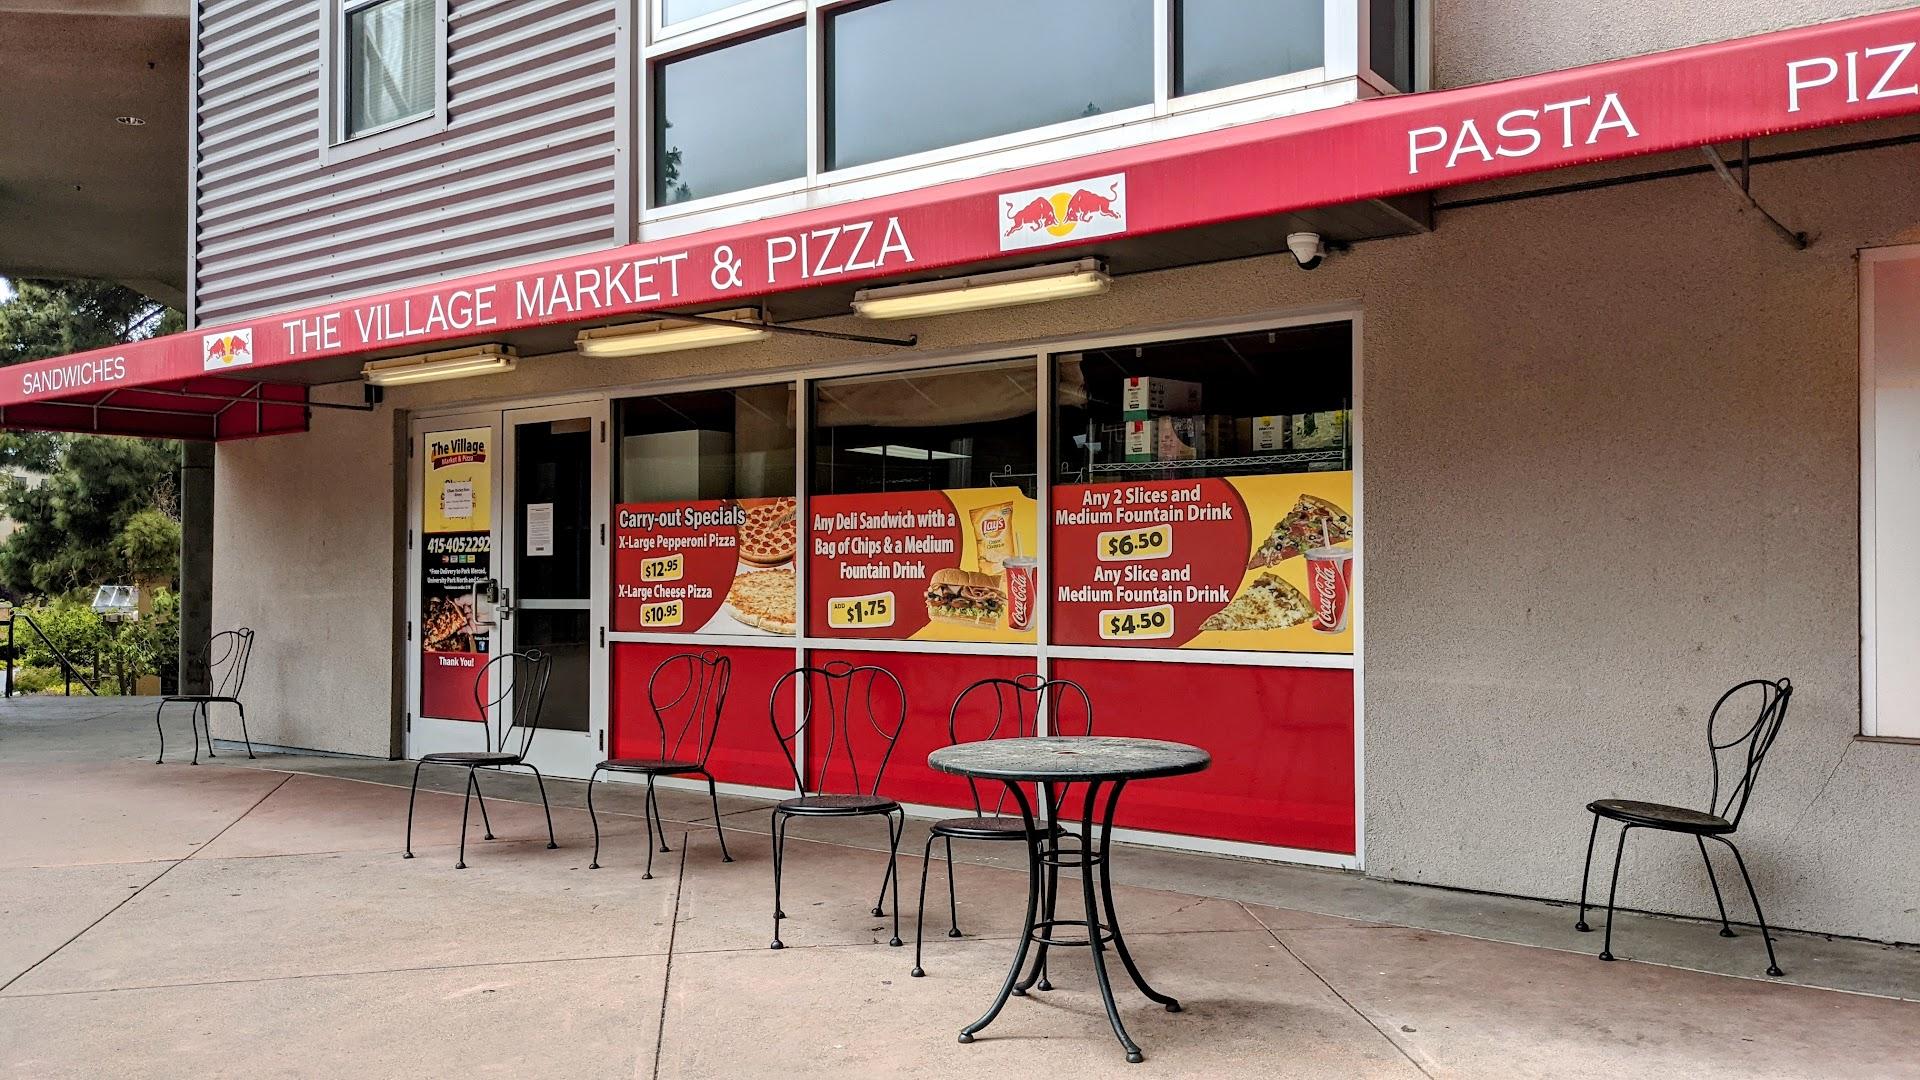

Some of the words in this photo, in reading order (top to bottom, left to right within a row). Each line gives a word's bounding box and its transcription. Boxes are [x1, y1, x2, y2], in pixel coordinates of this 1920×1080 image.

[1408, 92, 1640, 174] PASTA
[283, 312, 341, 354] THE
[355, 285, 496, 343] VILLAGE
[516, 251, 688, 320] MARKET
[710, 245, 743, 290] &
[766, 216, 915, 283] PIZZA
[23, 356, 125, 395] SANDWICHES
[431, 441, 449, 457] The
[451, 438, 485, 455] Village
[1082, 490, 1111, 509] Any
[1113, 489, 1123, 504] 2
[1125, 486, 1167, 504] Slices
[1171, 484, 1201, 502] and
[619, 509, 682, 531] Carry-out
[684, 506, 746, 530] Specials
[813, 513, 835, 535] Any
[836, 512, 858, 530] Deli
[860, 510, 915, 529] Sandwich
[917, 509, 945, 528] with
[947, 513, 955, 527] a
[1055, 508, 1112, 525] Medium
[1116, 505, 1184, 523] Fountain
[1187, 503, 1233, 521] Drink
[983, 518, 1004, 534] Lay's
[619, 535, 655, 552] X-Large
[656, 533, 707, 551] Pepperoni
[709, 533, 736, 547] Pizza
[815, 538, 836, 559] Bag
[837, 537, 851, 554] of
[851, 537, 881, 558] Chips
[883, 536, 893, 554] &
[895, 539, 903, 553] a
[904, 535, 954, 553] Medium
[1108, 531, 1163, 556] $6.50
[645, 560, 678, 577] $12.95
[840, 561, 890, 579] Fountain
[893, 561, 925, 579] Drink
[1093, 565, 1122, 585] Any
[1124, 565, 1158, 582] Slice
[1161, 564, 1190, 581] and
[618, 584, 653, 601] X-Large
[653, 584, 686, 598] Cheese
[688, 584, 713, 598] Pizza
[1058, 585, 1113, 602] Medium
[1116, 585, 1183, 603] Fountain
[1186, 585, 1230, 603] Drink
[645, 605, 677, 623] $10.95
[847, 599, 887, 624] $1.75
[1110, 611, 1165, 635] $4.50
[439, 656, 459, 666] Thank
[460, 657, 474, 667] You!
